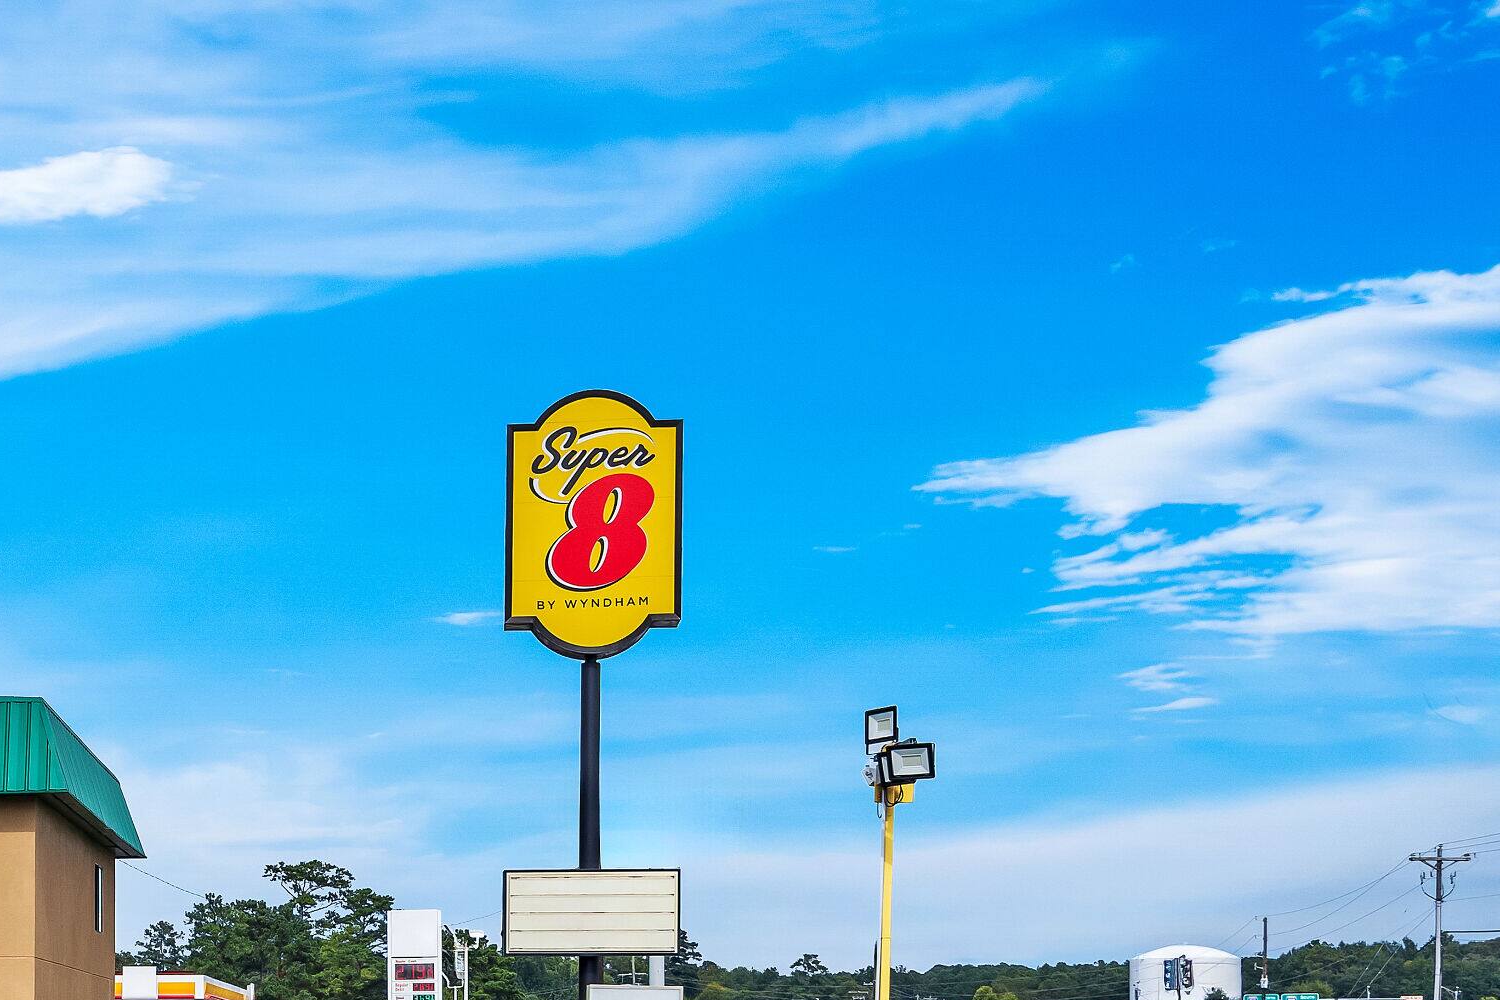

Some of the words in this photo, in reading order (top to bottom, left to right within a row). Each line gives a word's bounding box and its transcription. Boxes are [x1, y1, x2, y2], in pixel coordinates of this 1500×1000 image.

[531, 426, 656, 497] Super
[545, 473, 655, 592] 8
[536, 599, 556, 610] BY
[564, 596, 649, 609] WYNDHAM
